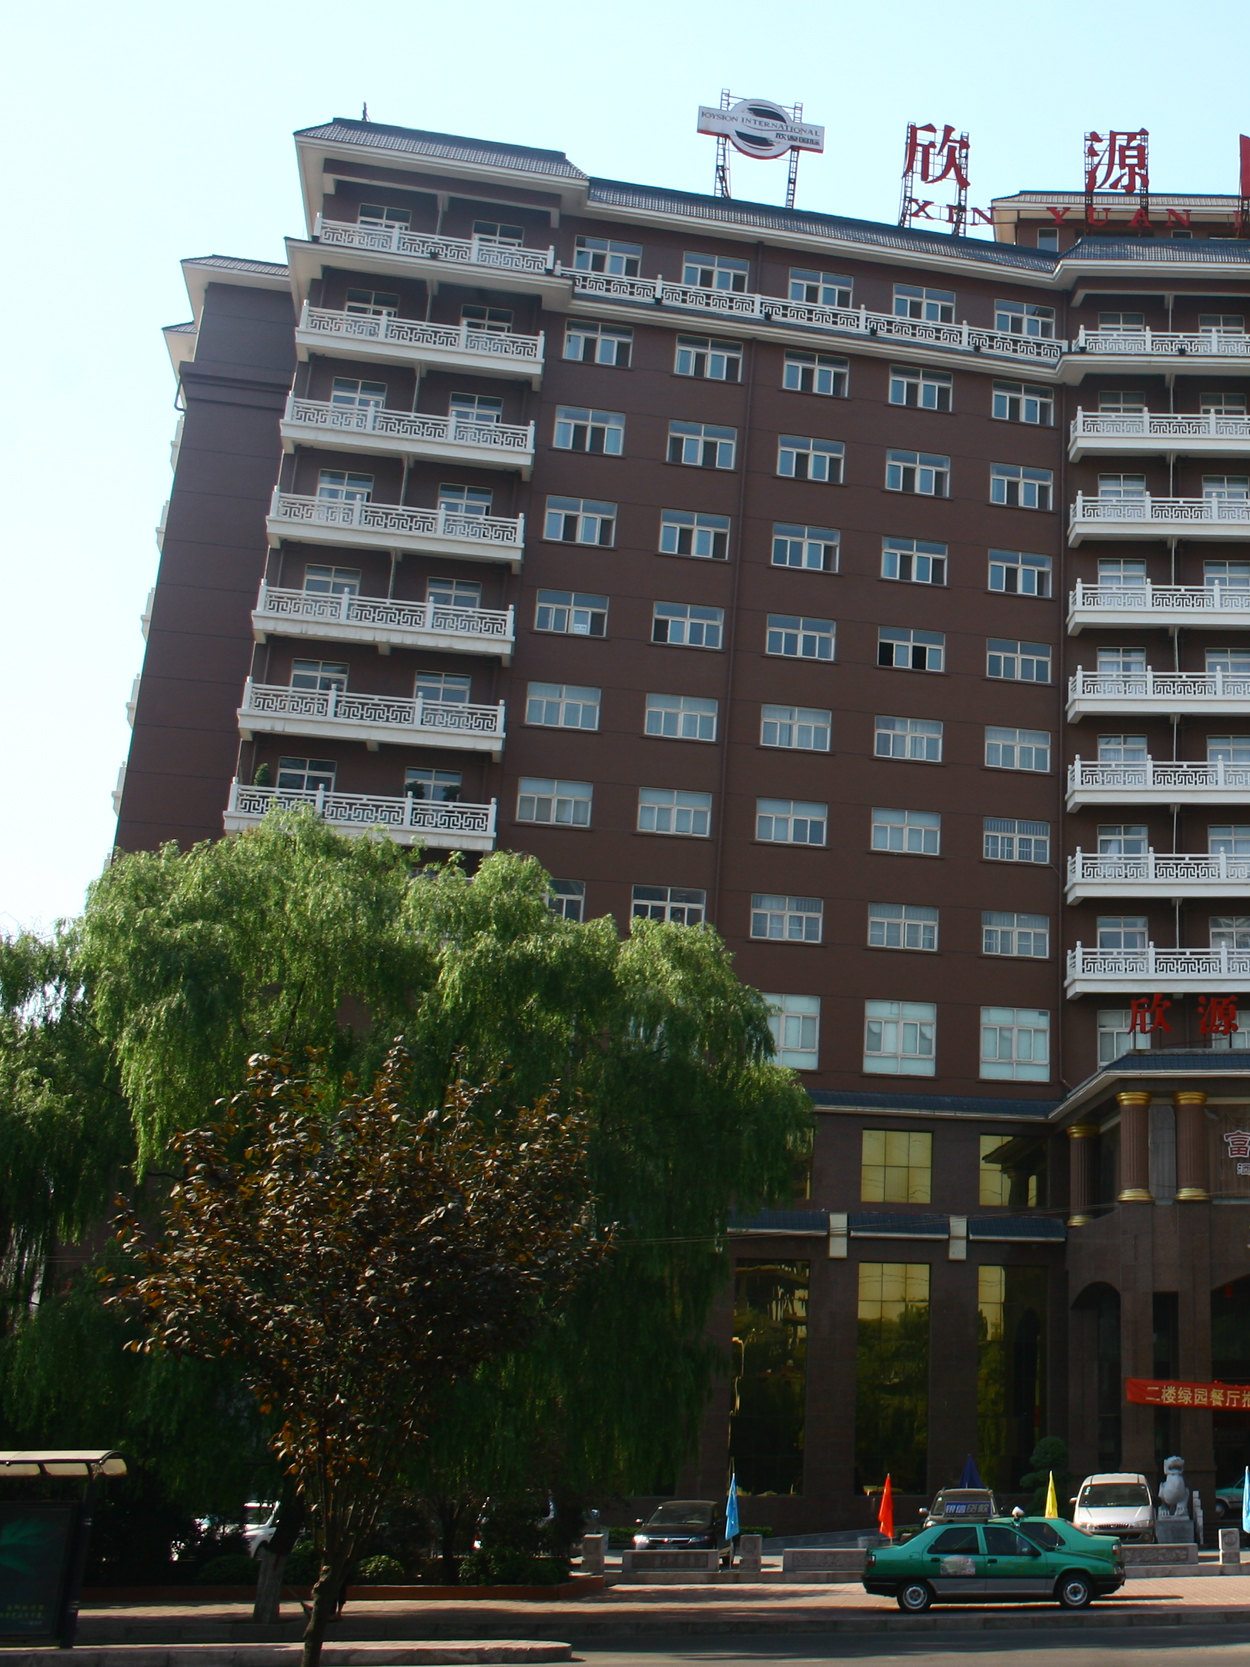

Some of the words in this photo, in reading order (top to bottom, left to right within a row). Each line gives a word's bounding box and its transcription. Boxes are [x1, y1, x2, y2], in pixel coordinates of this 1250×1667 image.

[741, 117, 820, 137] INTERNATIONAL
[911, 198, 996, 226] XIN
[1047, 206, 1192, 228] YUAN
